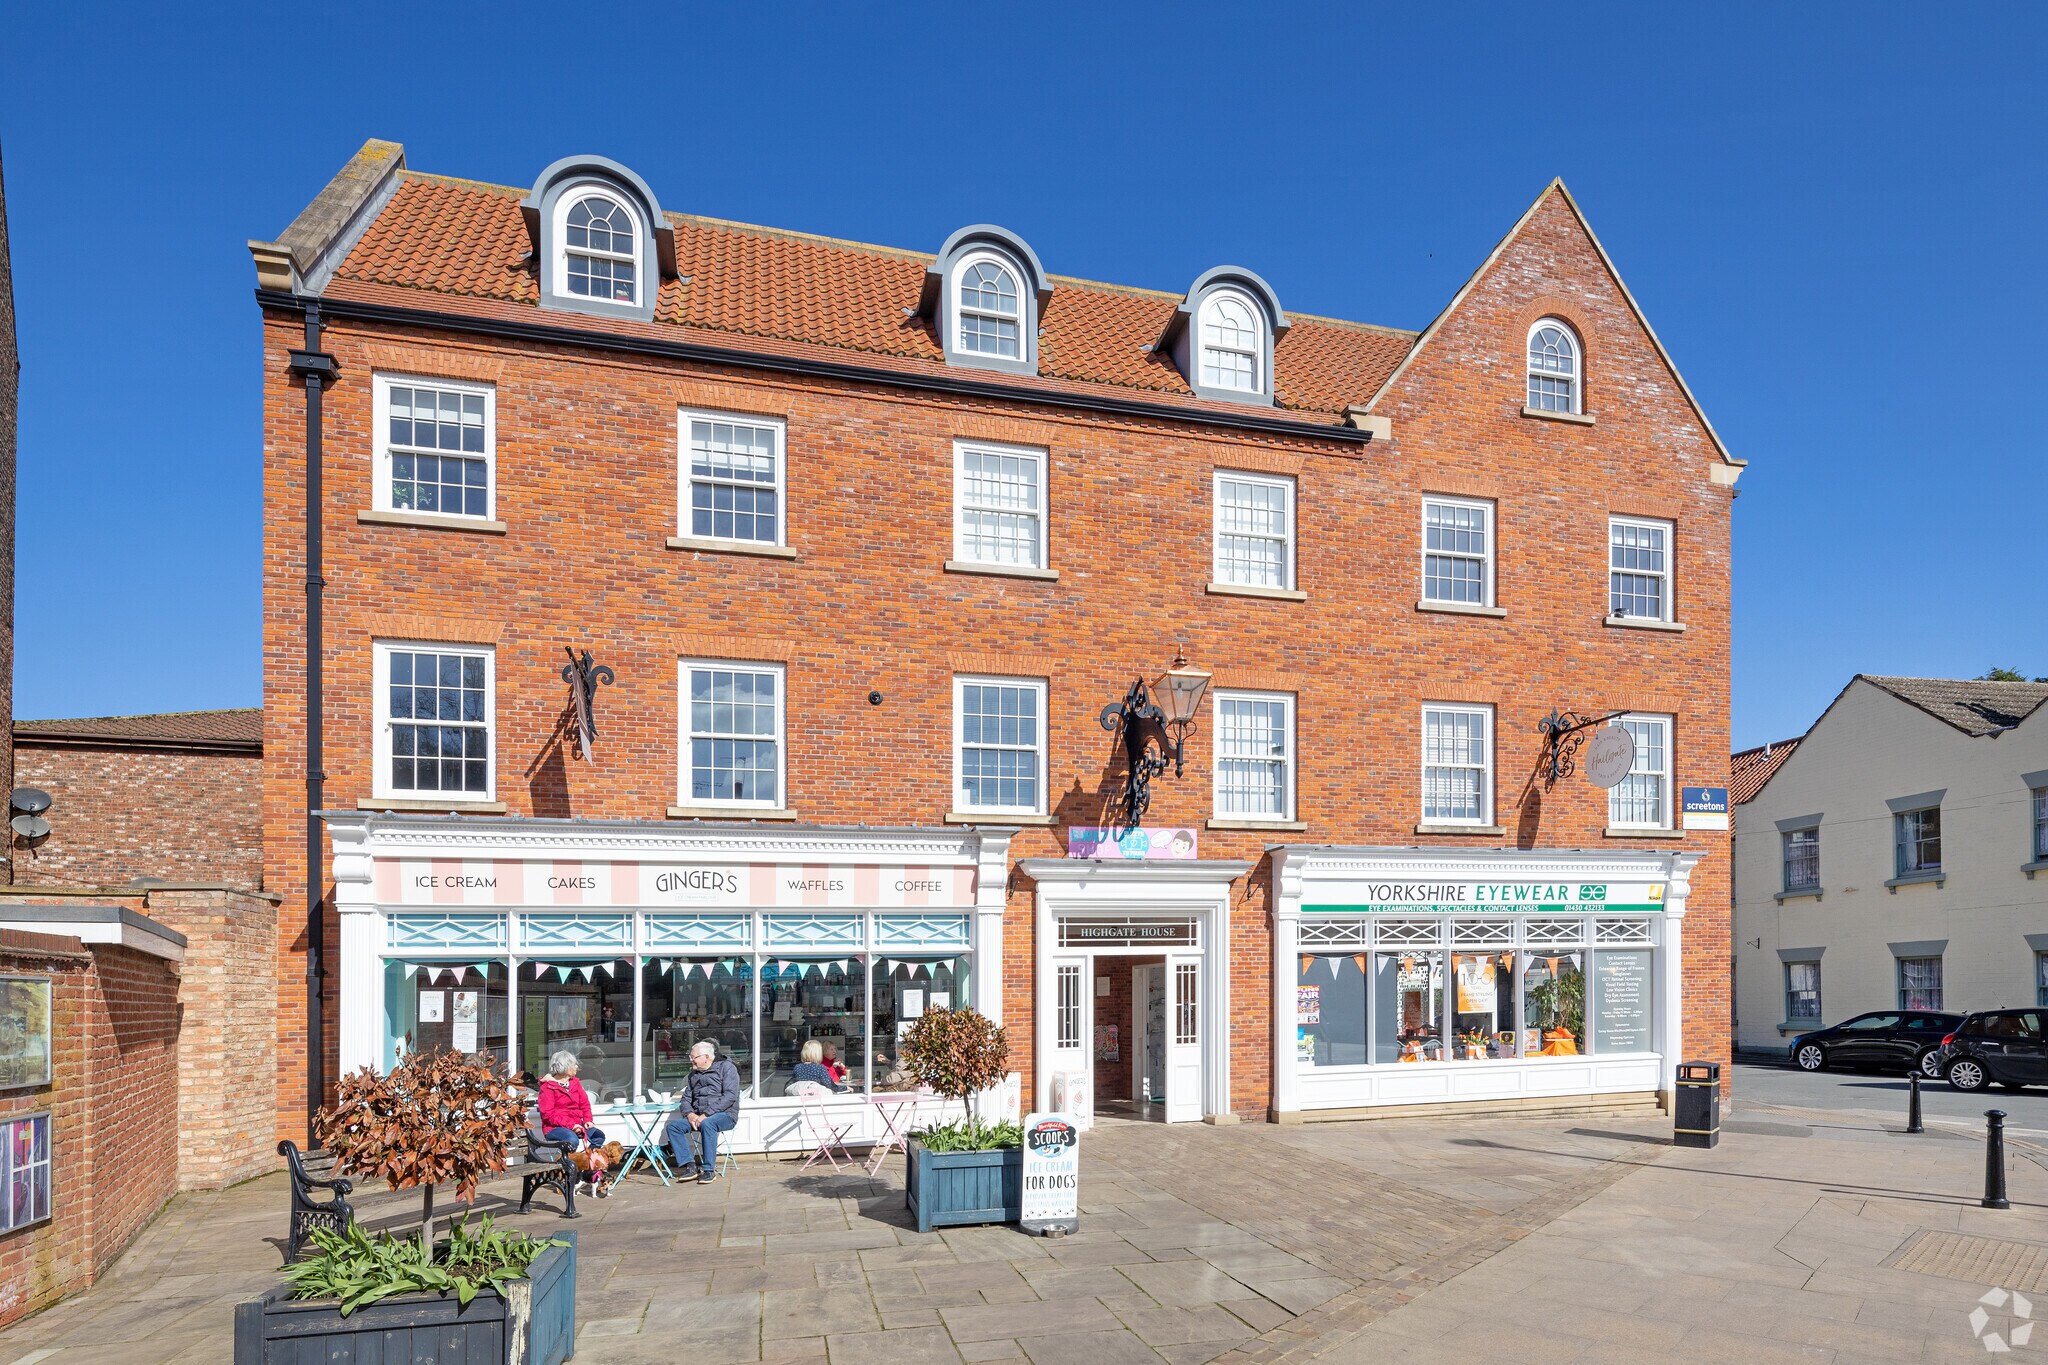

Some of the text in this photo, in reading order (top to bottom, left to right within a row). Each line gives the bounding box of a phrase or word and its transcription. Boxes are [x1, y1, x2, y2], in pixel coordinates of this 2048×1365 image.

[1686, 802, 1725, 811] screetons
[415, 876, 497, 888] ICE CREAM
[547, 877, 596, 889] CAKES
[787, 880, 844, 891] WAFFLES
[894, 881, 942, 892] COFFEE
[1368, 884, 1569, 901] YORKSHIRE EYEWEAR
[1382, 905, 1434, 913] EXAMINATIONS,
[1564, 904, 1605, 912] 01430 432133
[1081, 927, 1176, 937] HIGHGATE HOUSE
[1035, 1130, 1070, 1145] SCOOP'S
[1029, 1160, 1073, 1174] ICE CREAM
[1025, 1174, 1076, 1190] FOR DOGS
